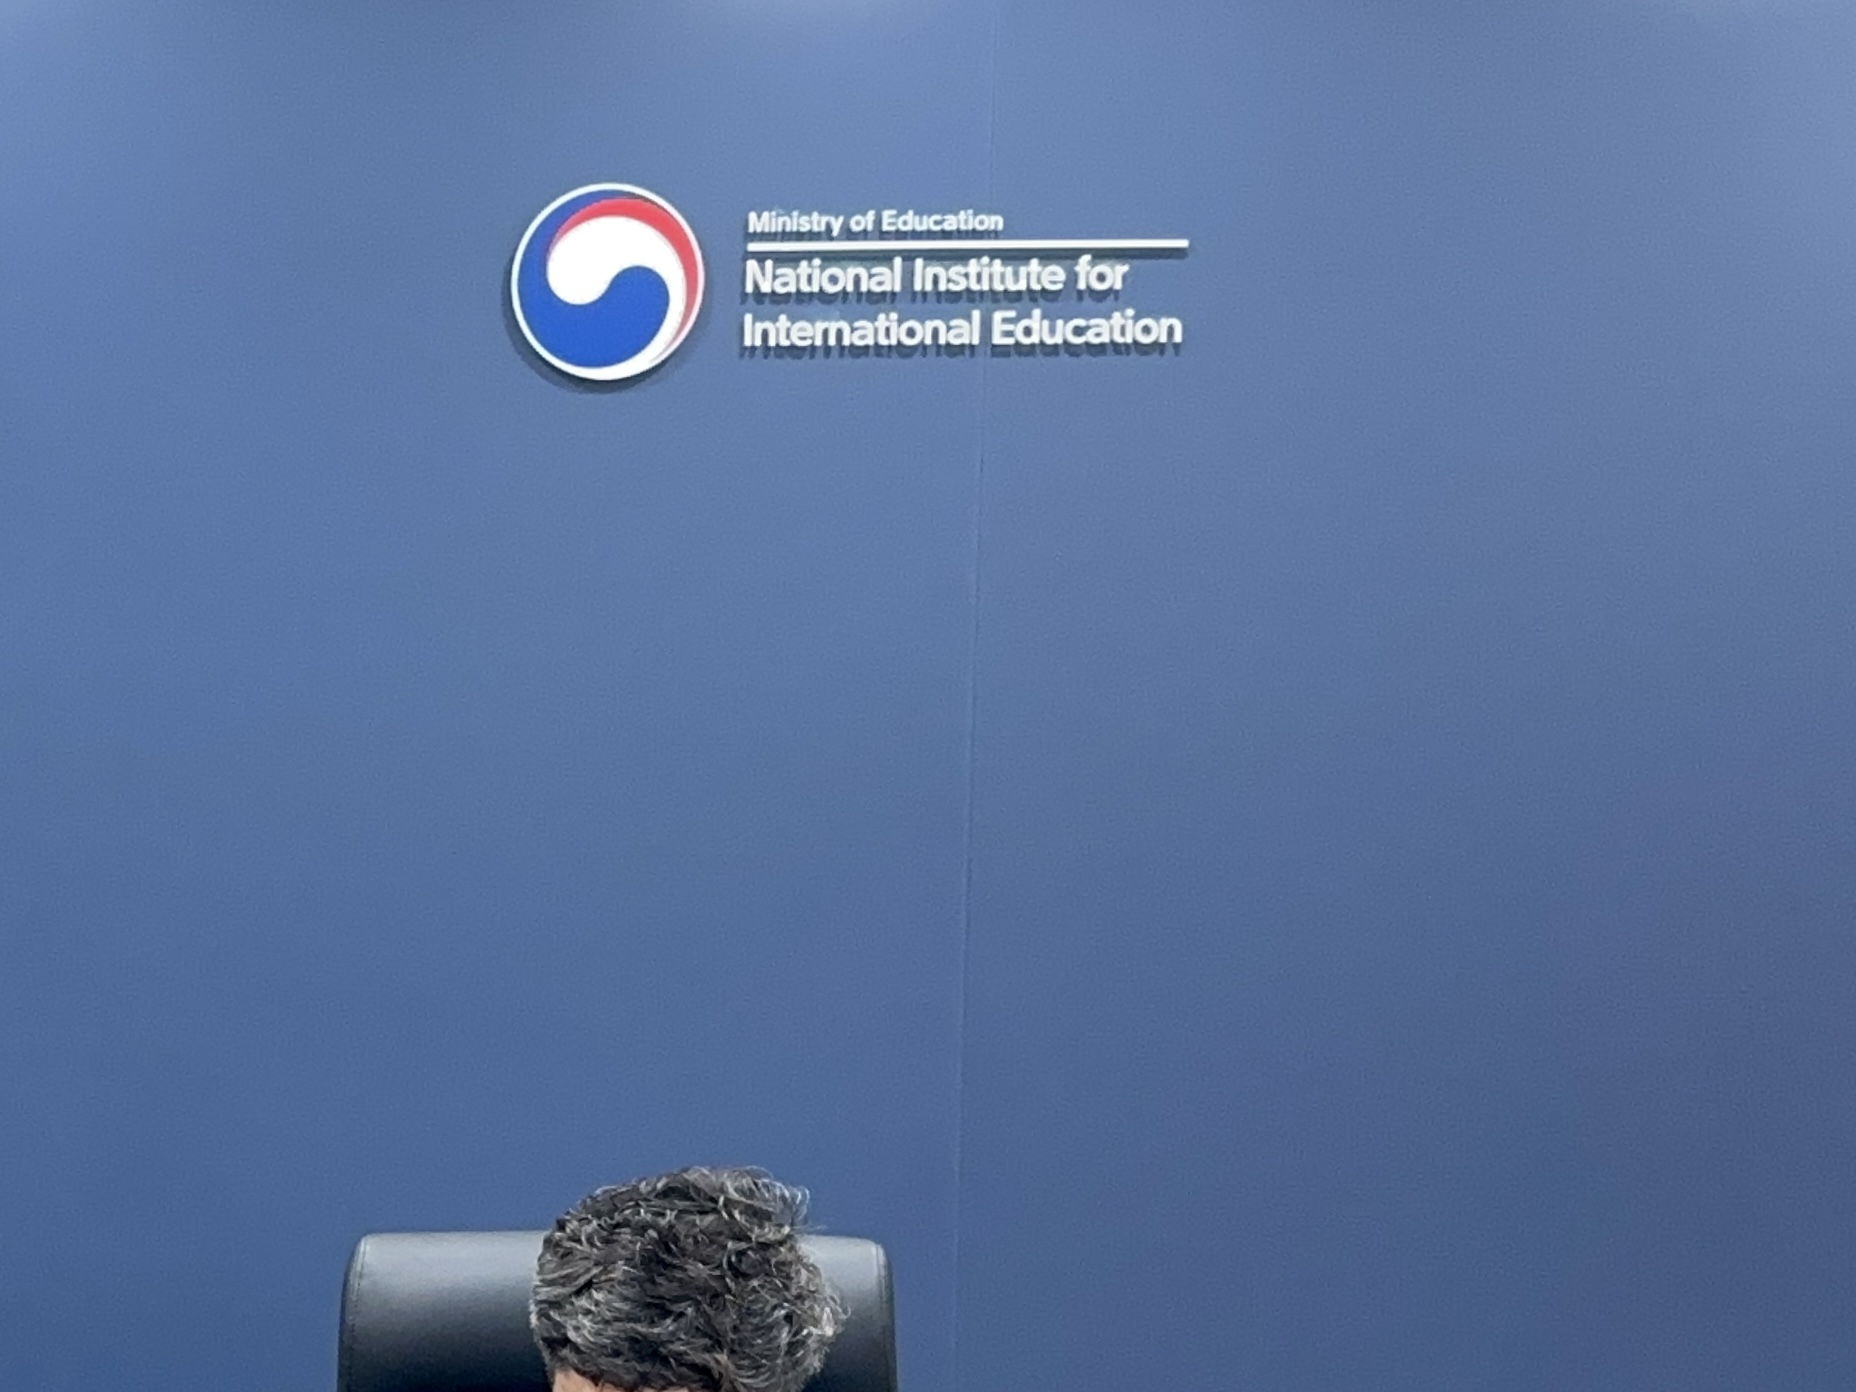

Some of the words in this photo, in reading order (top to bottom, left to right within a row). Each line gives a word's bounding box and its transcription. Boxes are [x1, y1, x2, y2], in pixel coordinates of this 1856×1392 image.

[747, 210, 844, 236] Ministry
[849, 210, 876, 232] of
[881, 210, 1004, 233] Education
[745, 256, 902, 294] National
[913, 255, 1066, 293] Institute
[1073, 253, 1129, 291] for
[743, 311, 981, 348] International
[990, 309, 1183, 346] Education
